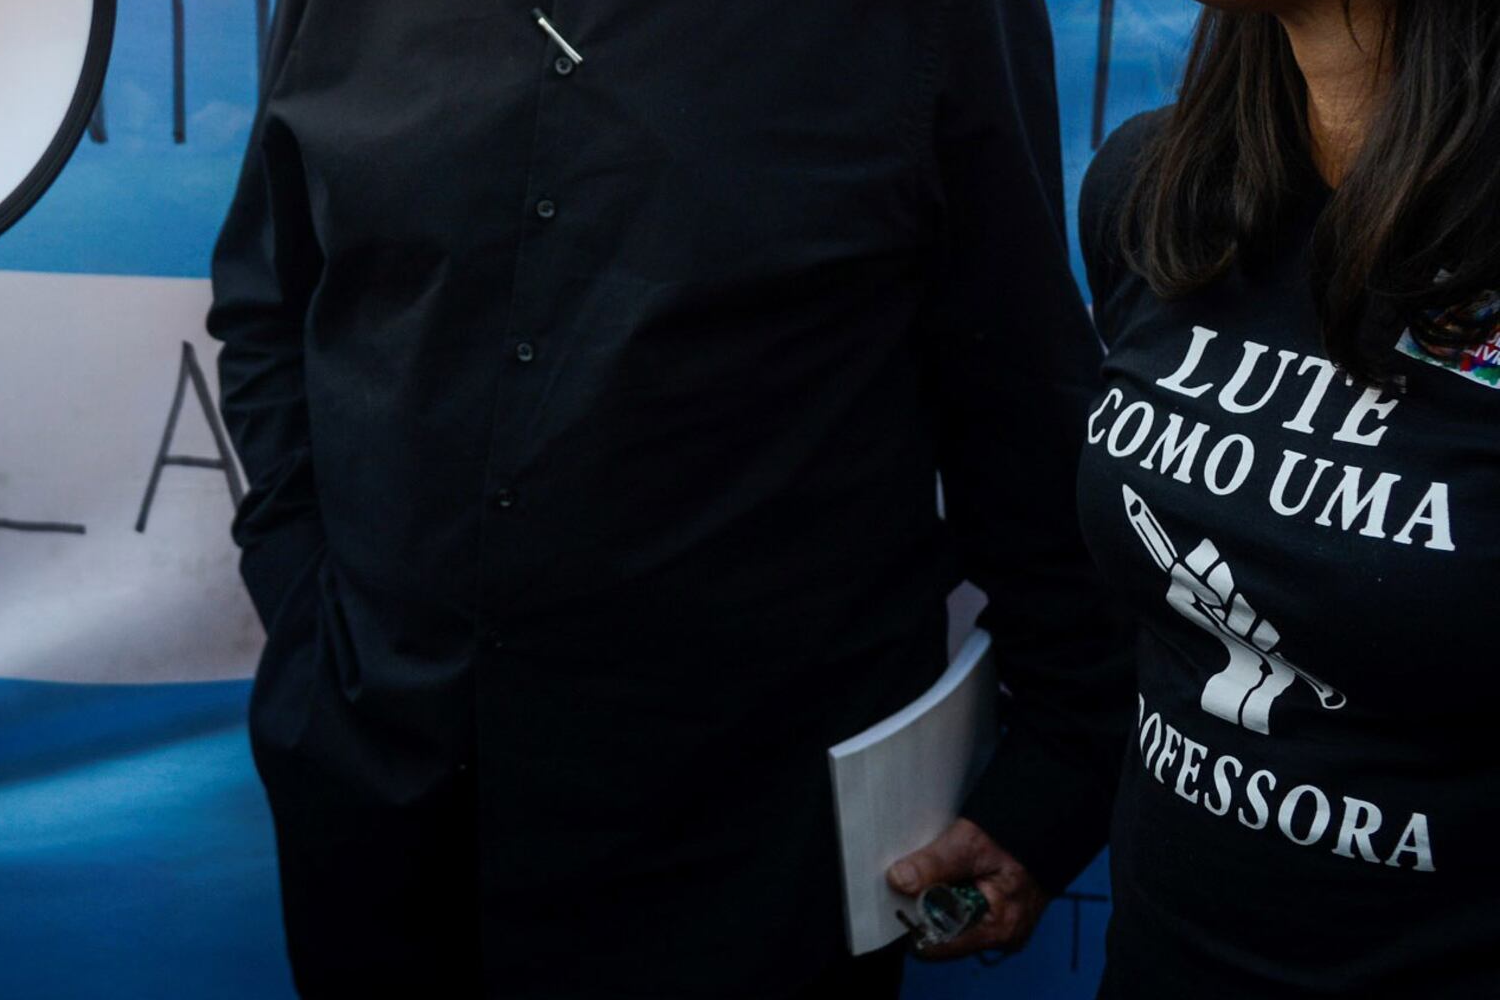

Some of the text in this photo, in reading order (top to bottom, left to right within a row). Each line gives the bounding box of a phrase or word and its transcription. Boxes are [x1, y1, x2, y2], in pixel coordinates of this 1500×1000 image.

[1156, 325, 1400, 447] LUTE
[1088, 388, 1456, 551] COMO UMA
[1138, 692, 1436, 873] OFESSORA
